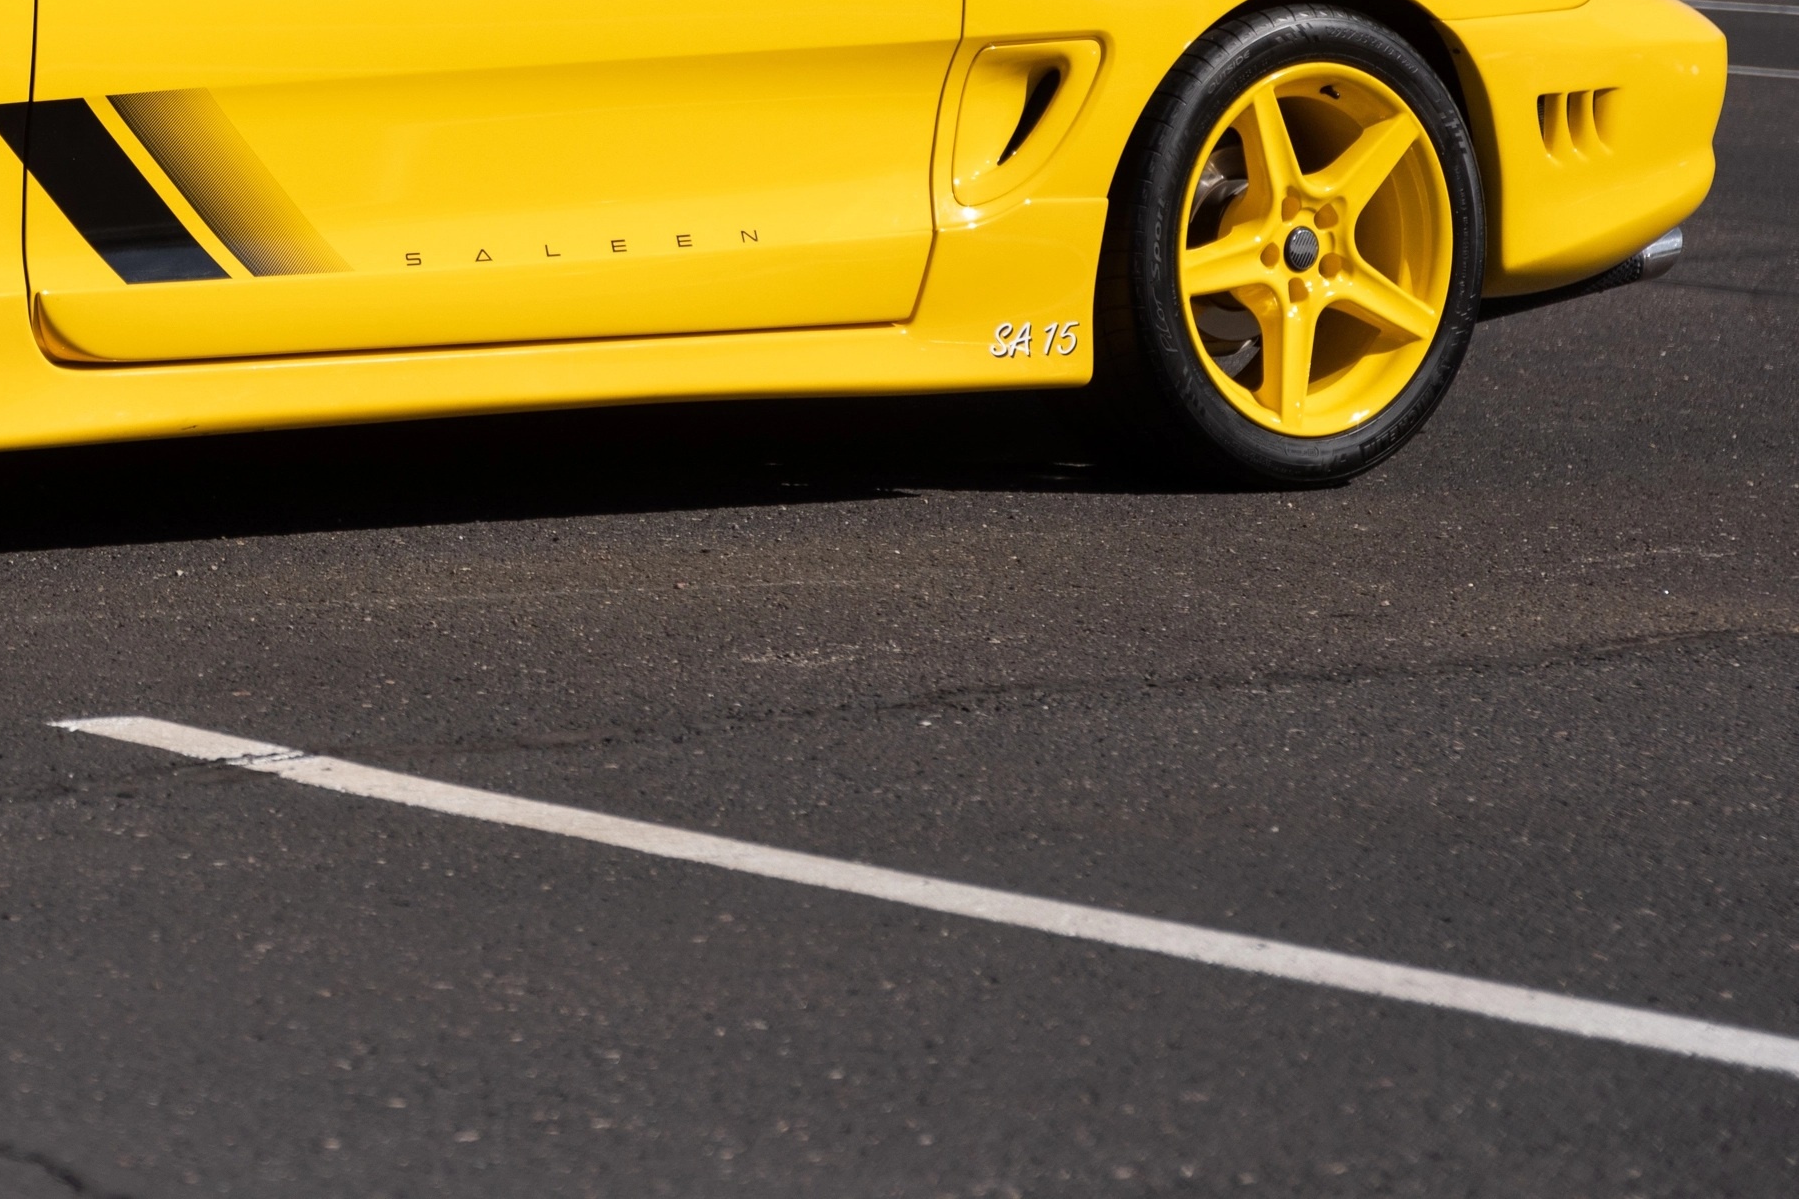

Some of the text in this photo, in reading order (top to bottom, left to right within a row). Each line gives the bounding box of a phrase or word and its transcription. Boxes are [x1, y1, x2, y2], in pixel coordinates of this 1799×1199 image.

[1207, 49, 1251, 94] OUTSIDE
[404, 229, 760, 267] SALEEN
[989, 320, 1081, 359] SA 15
